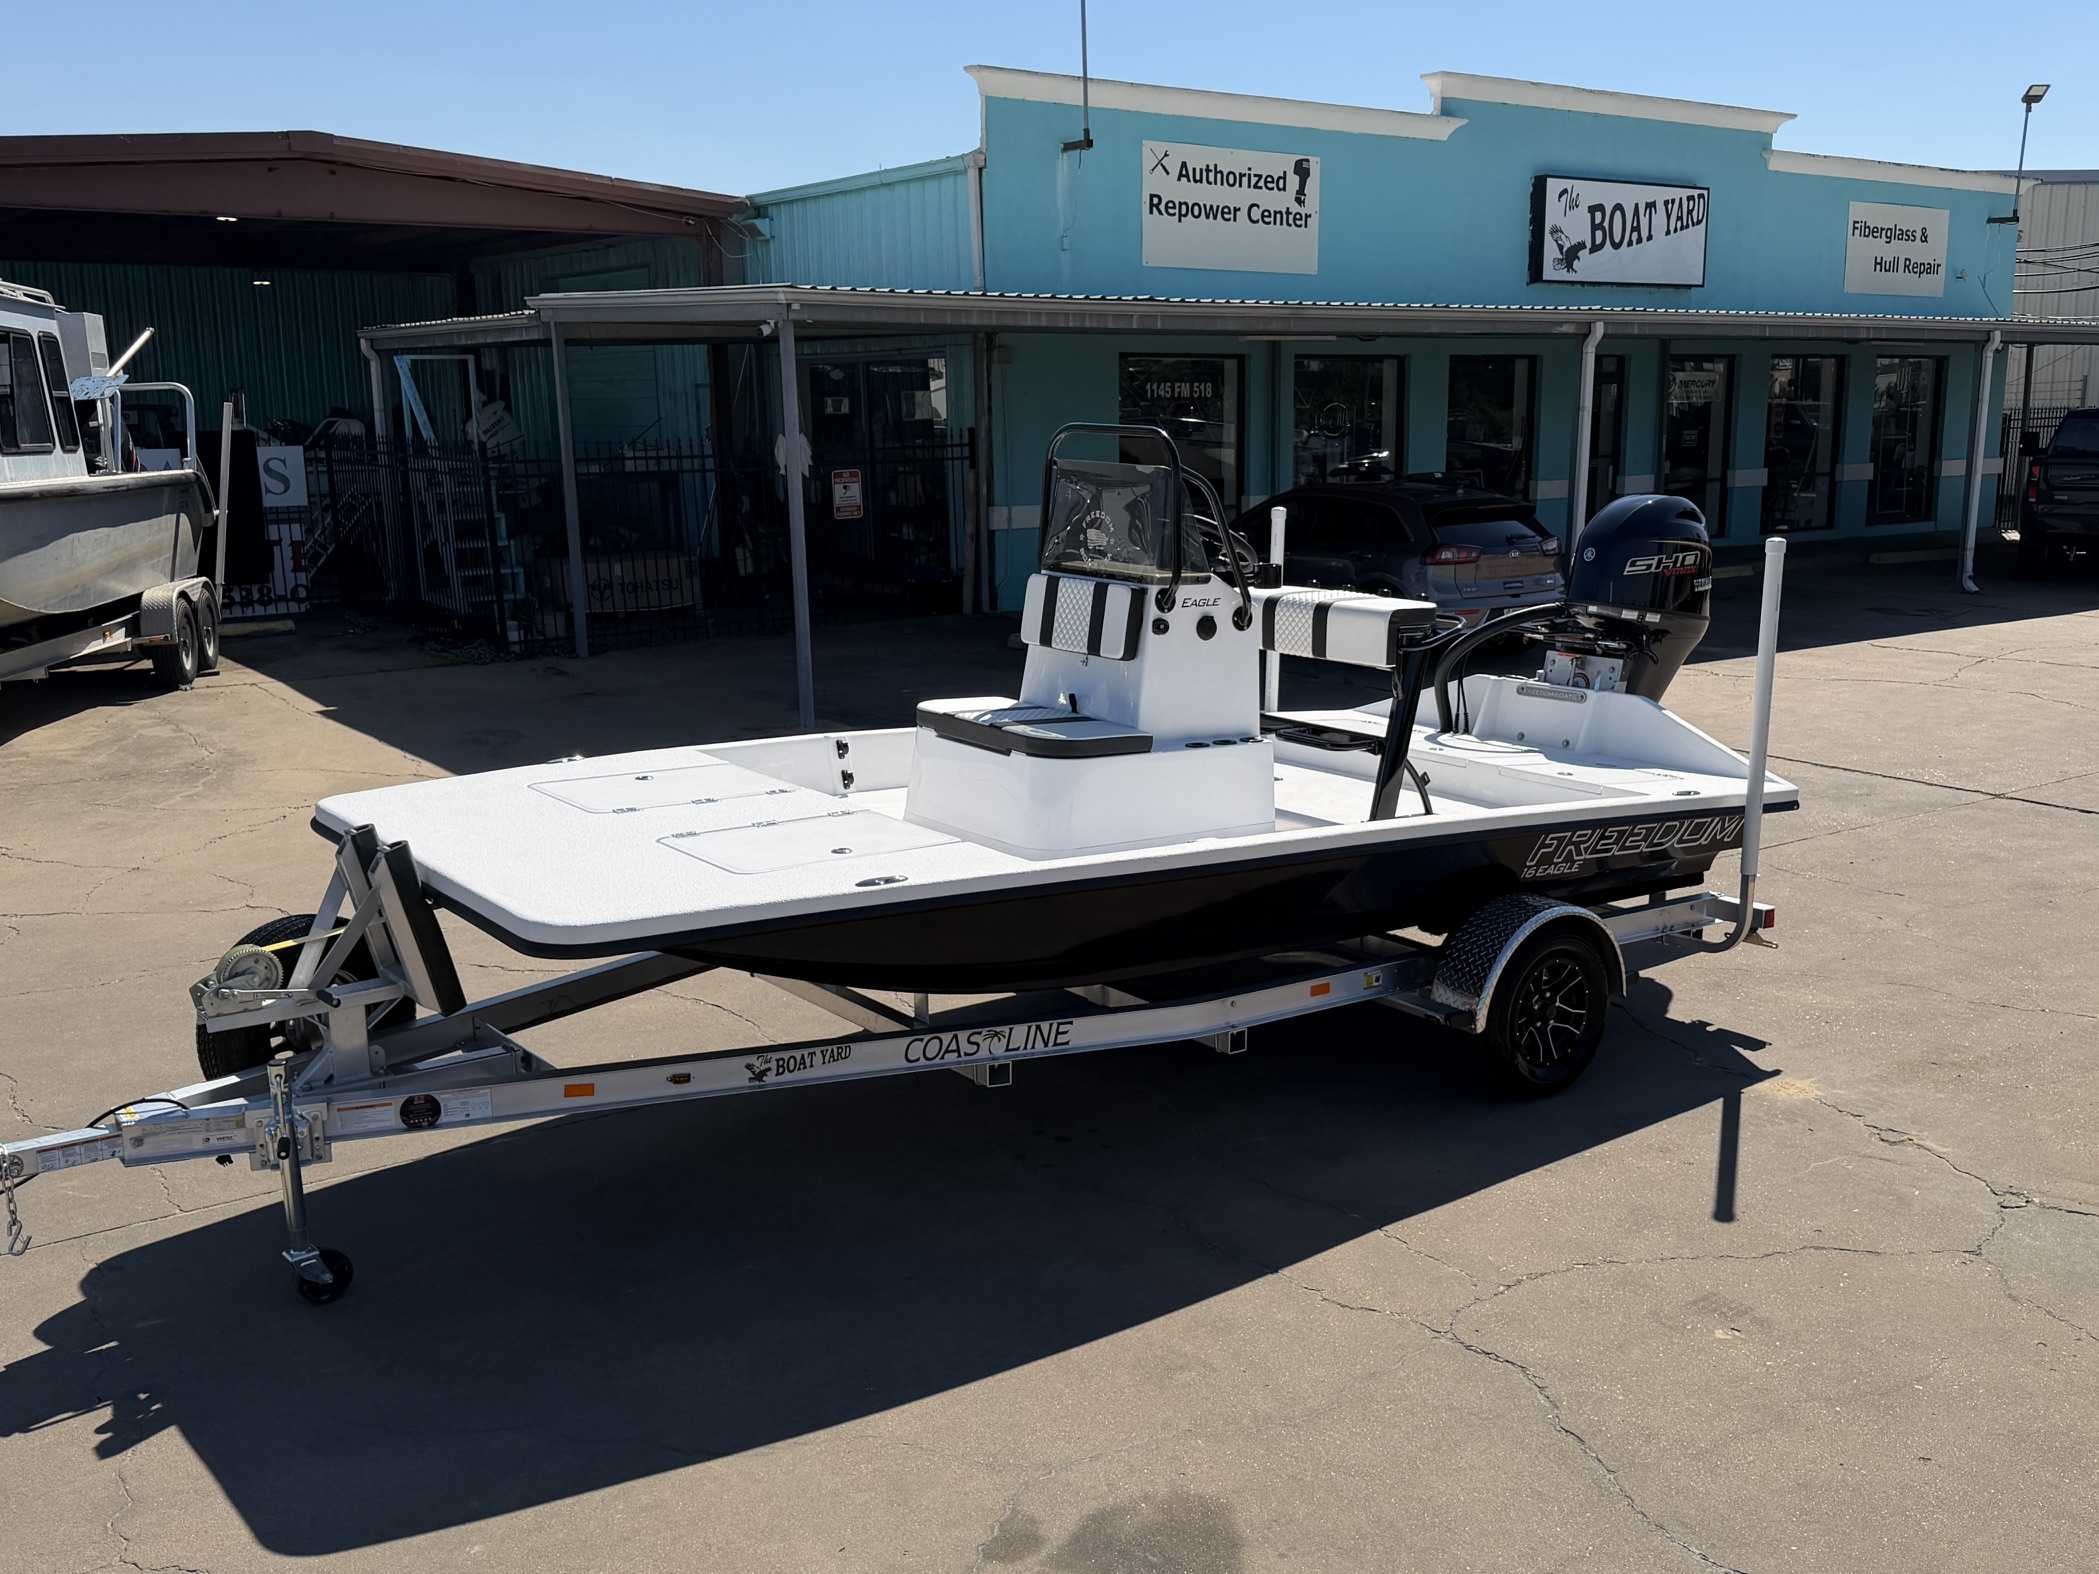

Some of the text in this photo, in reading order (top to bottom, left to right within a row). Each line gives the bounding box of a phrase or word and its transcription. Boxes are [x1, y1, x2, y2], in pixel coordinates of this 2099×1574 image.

[1177, 161, 1287, 192] Authorized
[1148, 193, 1312, 229] Repower Center
[1557, 184, 1580, 217] The
[1587, 192, 1706, 255] BOAT YARD
[1852, 220, 1929, 244] Fiberglass &
[1873, 256, 1942, 278] Hull Repair
[1145, 382, 1212, 400] 1145 FM 518
[1624, 551, 1700, 576] SHO
[1181, 597, 1222, 608] EAGLE
[1526, 816, 1744, 867] FREEDOM
[1536, 861, 1583, 877] EAGLE
[775, 1045, 852, 1077] BOAT YARD
